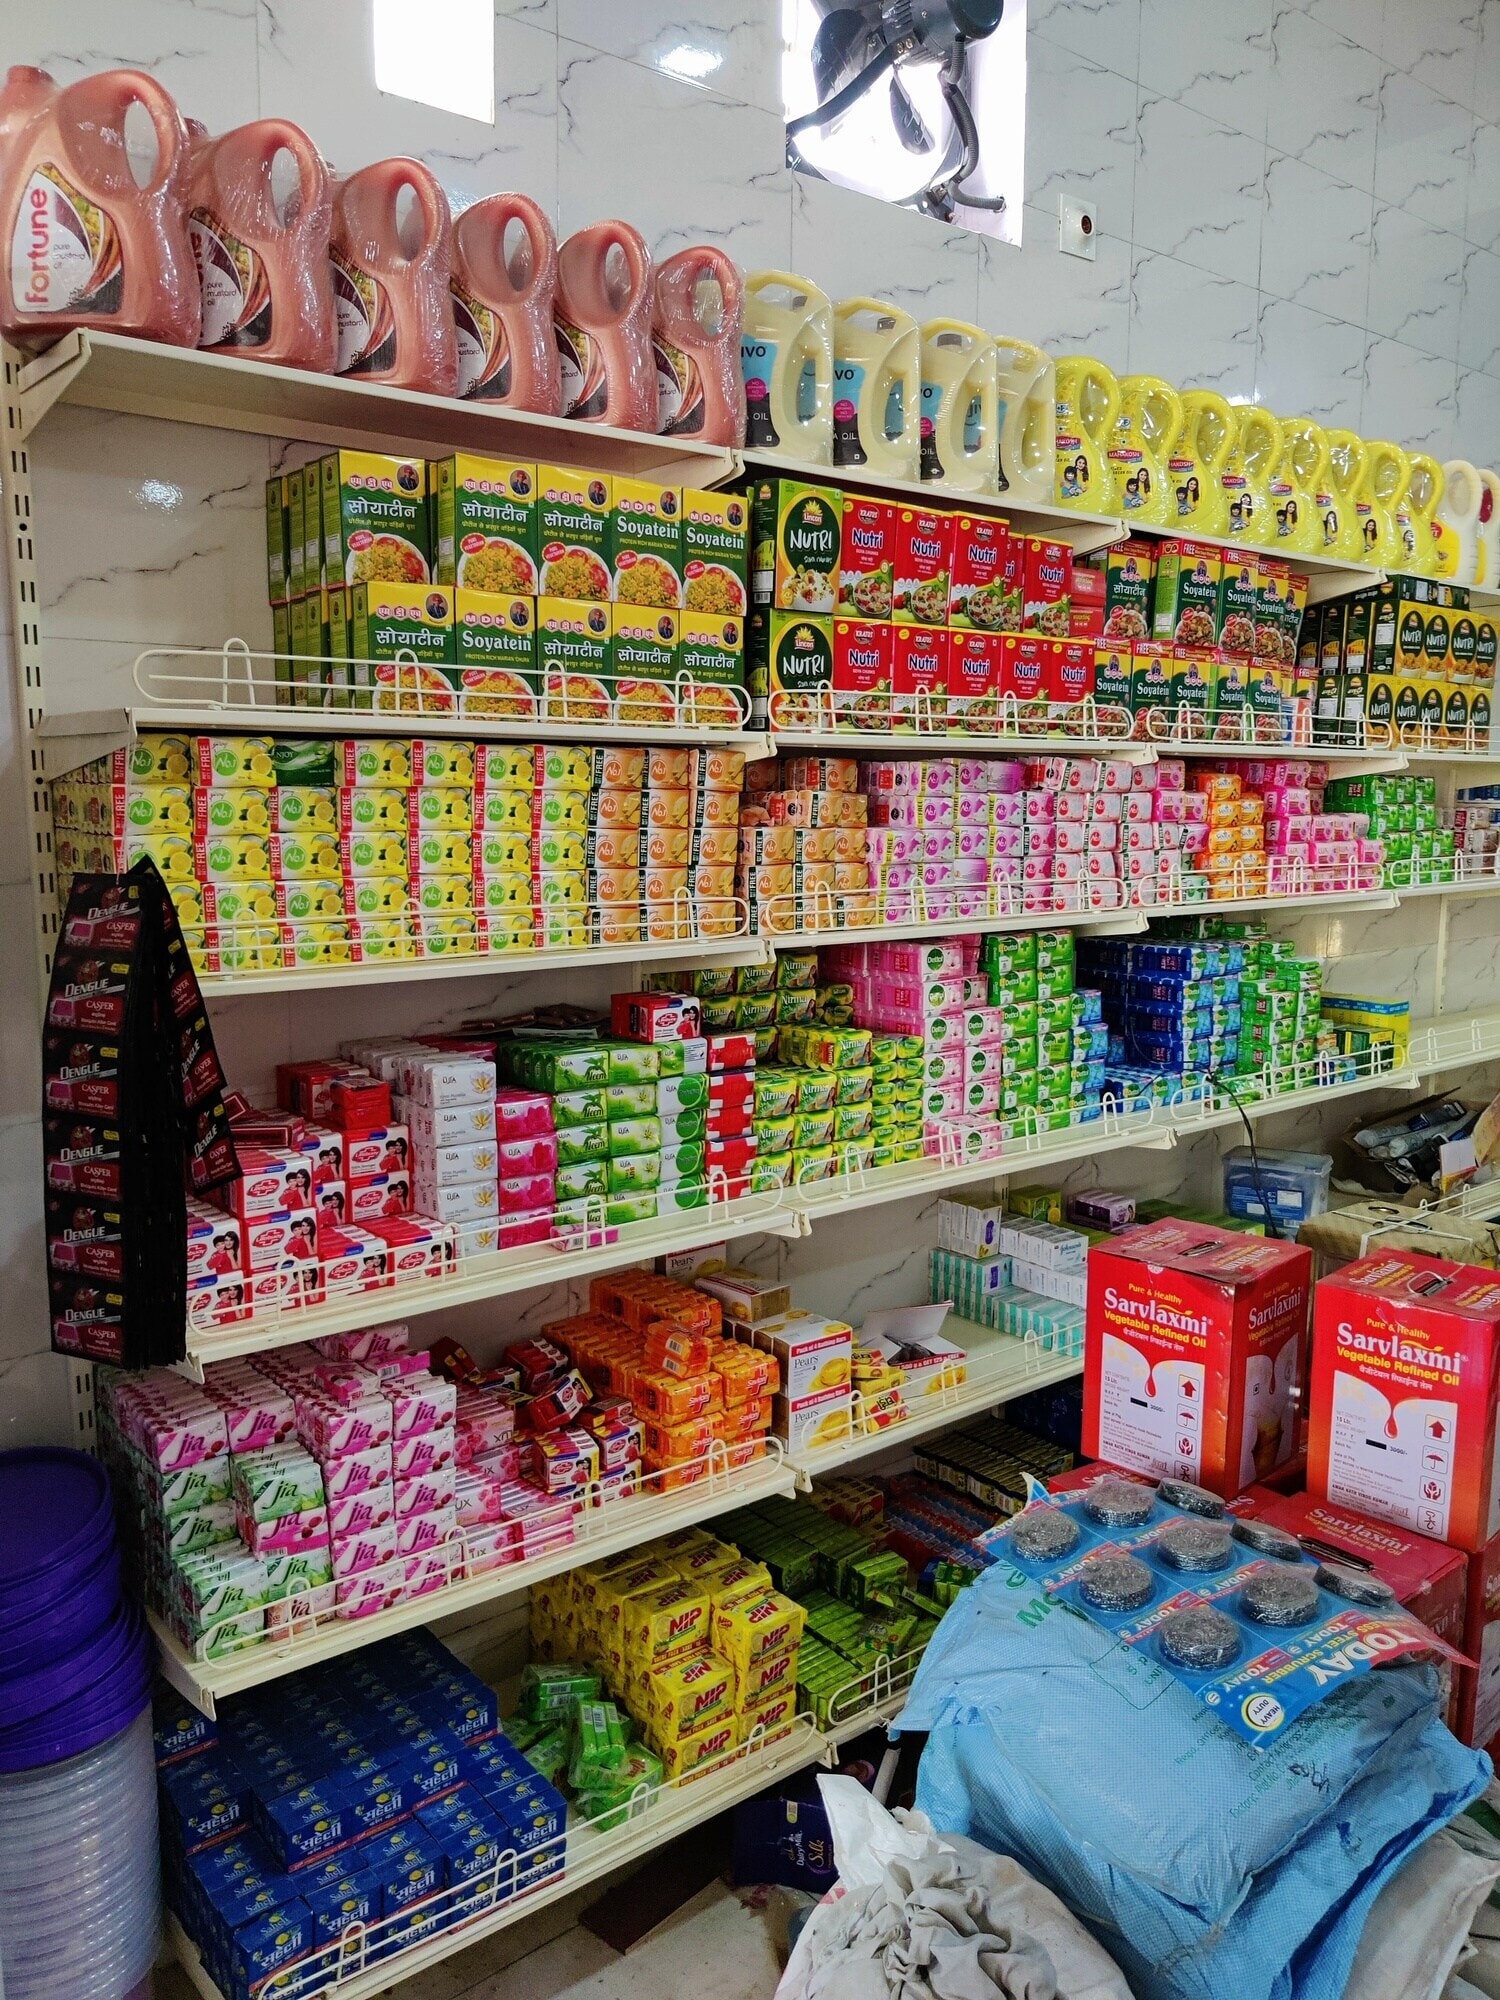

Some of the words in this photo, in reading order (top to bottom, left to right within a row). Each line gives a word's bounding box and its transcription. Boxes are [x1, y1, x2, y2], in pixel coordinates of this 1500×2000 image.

[25, 189, 49, 304] fortune
[207, 282, 223, 290] pure
[741, 346, 766, 358] IVO
[753, 413, 769, 421] OIL
[841, 432, 857, 440] OIL
[348, 497, 417, 518] सोयाटीन
[462, 500, 529, 522] सोयाटीन
[544, 510, 604, 532] सोयाटीन
[617, 516, 679, 539] Soyatein
[686, 527, 744, 549] Soyatein
[790, 529, 832, 551] NUTRI
[852, 528, 883, 549] Nutri
[911, 537, 941, 559] Nutri
[968, 544, 997, 564] Nutri
[1183, 543, 1195, 555] FREE
[1039, 564, 1064, 584] Nutri
[1183, 582, 1216, 598] Soyatein
[1227, 589, 1256, 604] Soyatein
[1256, 600, 1284, 614] Soyatein
[375, 628, 446, 647] सोयाटीन
[462, 630, 532, 652] Soyatein
[544, 639, 604, 659] सोयाटीन
[617, 646, 672, 665] सोयाटीन
[849, 649, 879, 667] Nutri
[684, 652, 736, 669] सोयाटीन
[783, 654, 825, 676] NUTRI
[908, 654, 937, 671] Nutri
[962, 658, 990, 675] Nutri
[1013, 662, 1040, 678] Nutri
[1061, 667, 1086, 683] Nutri
[1096, 677, 1129, 694] Soyatein
[1137, 679, 1170, 697] Soyatein
[199, 795, 207, 819] FREE
[87, 902, 129, 921] DENGUE
[106, 922, 136, 932] CASPER
[700, 970, 728, 982] Nirma
[743, 968, 770, 979] Nirma
[784, 961, 809, 972] Nirma
[65, 979, 109, 998] DENGUE
[86, 1001, 114, 1012] CASPER
[742, 1005, 769, 1017] Nirma
[60, 1062, 100, 1080] DENGUE
[587, 1069, 607, 1081] Neem
[81, 1084, 109, 1095] CASPER
[759, 1091, 787, 1103] Nirma
[583, 1108, 604, 1118] Neem
[800, 1122, 828, 1134] Nirma
[194, 1124, 218, 1158] DENGUE
[584, 1139, 605, 1151] Neem
[60, 1145, 104, 1163] DENGUE
[84, 1165, 111, 1177] CASPER
[583, 1184, 605, 1195] Neem
[63, 1226, 106, 1243] DENGUE
[86, 1247, 115, 1259] CASPER
[671, 1257, 694, 1268] Pears
[1129, 1283, 1145, 1294] Pure
[1154, 1291, 1182, 1305] Healthy
[65, 1307, 105, 1323] DENGUE
[1104, 1287, 1207, 1336] Sarvlaxmi
[1249, 1286, 1300, 1329] Sarvlaxmi
[88, 1327, 116, 1339] CASPER
[1104, 1310, 1150, 1331] Vegetable
[1152, 1324, 1189, 1344] Refined
[1192, 1336, 1206, 1348] Oil
[1367, 1318, 1385, 1329] Pure
[1397, 1325, 1430, 1341] Healthy
[1337, 1322, 1460, 1373] Sarvlaxmi
[794, 1355, 818, 1368] Pears
[1337, 1346, 1391, 1368] Vegetable
[1394, 1361, 1439, 1381] Refined
[1442, 1373, 1459, 1386] Oil
[237, 1410, 276, 1442] jia
[403, 1400, 437, 1435] jia
[794, 1409, 819, 1423] Pears
[340, 1420, 373, 1455] jia
[166, 1433, 206, 1467] jia
[403, 1440, 436, 1475] jia
[171, 1471, 208, 1508] jia
[404, 1481, 437, 1514] jia
[455, 1498, 471, 1511] UX
[340, 1502, 373, 1536] jia
[1134, 1526, 1168, 1546] ODAY
[1305, 1514, 1348, 1536] Vegetable
[1350, 1532, 1386, 1550] Refined
[1387, 1548, 1403, 1556] Oil
[1310, 1508, 1412, 1552] Sarvlaxmi
[343, 1541, 377, 1575] jia
[1058, 1556, 1095, 1579] ODAY
[1215, 1570, 1253, 1592] TODAY
[205, 1584, 244, 1616] jia
[669, 1607, 702, 1637] NIP
[1136, 1603, 1180, 1631] TODAY
[762, 1623, 790, 1650] NIP
[1305, 1622, 1350, 1648] TODAY
[1323, 1630, 1359, 1650] STEEL
[1261, 1649, 1324, 1684] SCRUBBER
[1306, 1628, 1421, 1687] TODAY
[761, 1656, 790, 1687] NIP
[1222, 1663, 1270, 1693] TODAY
[695, 1681, 727, 1713] NIP
[1253, 1699, 1270, 1716] DUTY
[1262, 1704, 1281, 1725] HEAVY
[698, 1728, 731, 1759] NIP
[420, 1762, 458, 1792] सहेली
[197, 1803, 241, 1836] सहेली
[450, 1813, 478, 1832] Saheli
[300, 1821, 342, 1852] सहेली
[383, 1836, 412, 1856] Saheli
[462, 1828, 490, 1848] Saheli
[462, 1845, 498, 1876] सहेली
[809, 1839, 825, 1868] Silk
[317, 1866, 347, 1886] Saheli
[396, 1869, 435, 1901] सहेली
[330, 1885, 360, 1904] Saheli
[327, 1901, 369, 1932] सहेली
